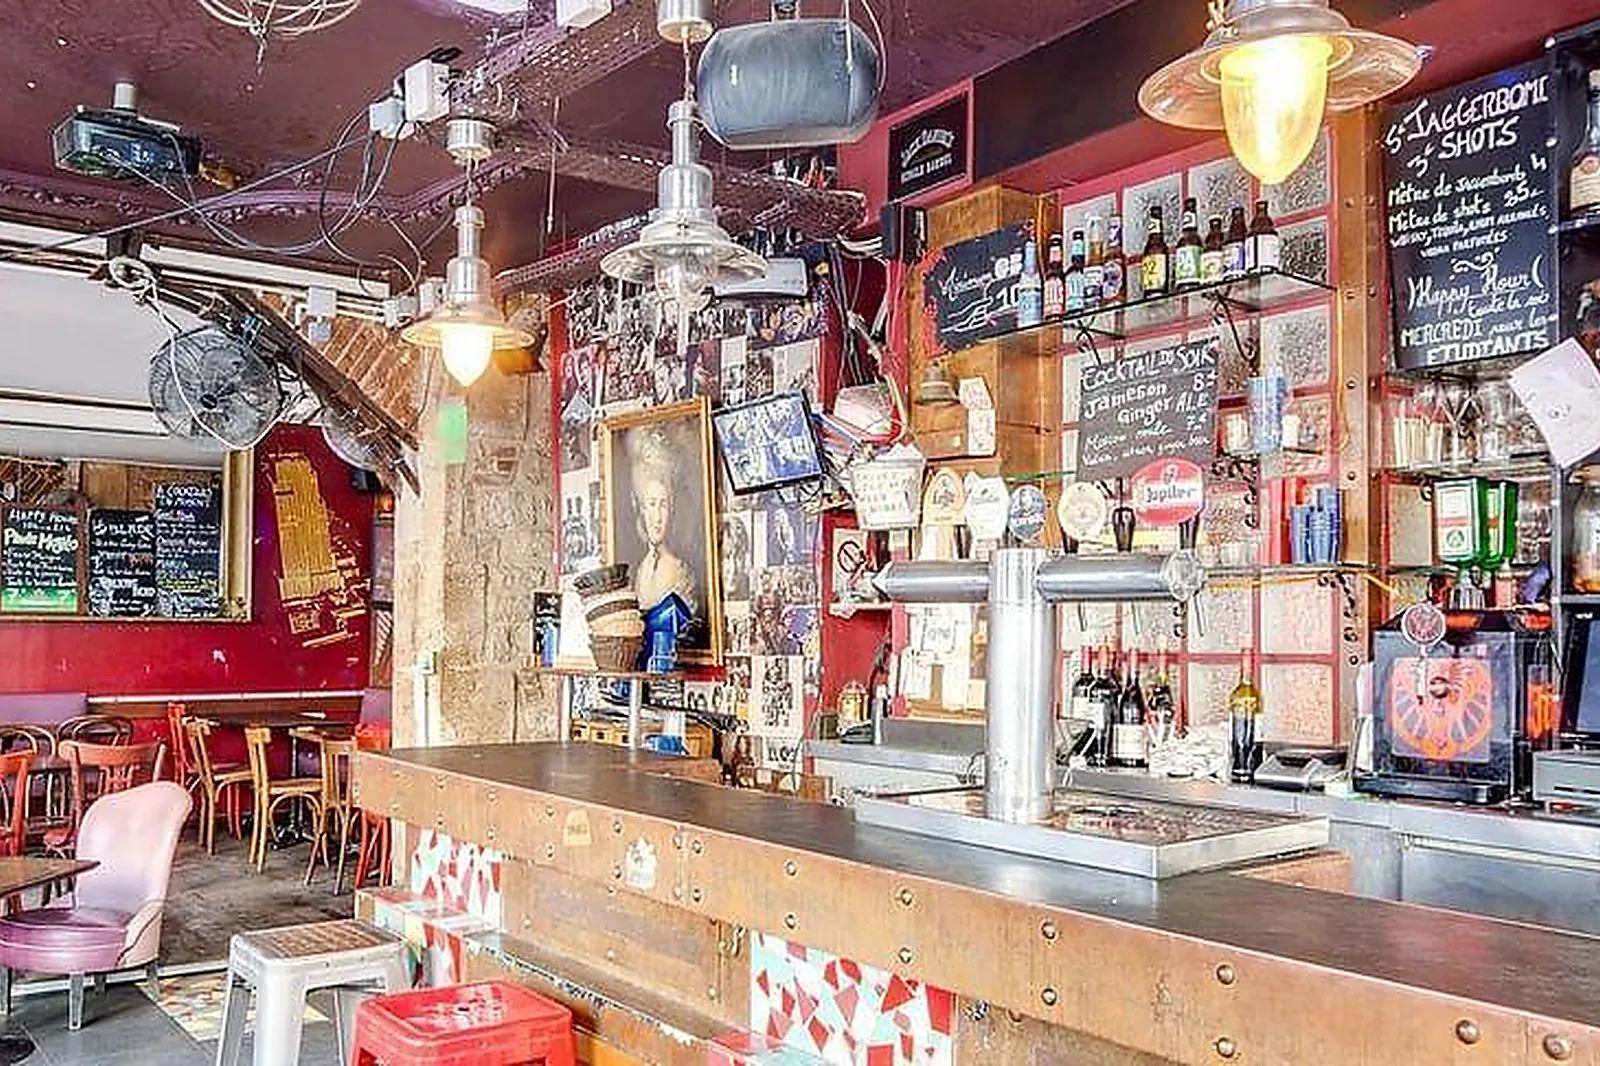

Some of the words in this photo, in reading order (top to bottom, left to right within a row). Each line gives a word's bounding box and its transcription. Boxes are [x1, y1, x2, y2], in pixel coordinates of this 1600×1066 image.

[1438, 115, 1520, 159] SHOTS
[1433, 172, 1452, 197] de
[1432, 202, 1448, 225] de
[1453, 193, 1492, 218] shots
[1400, 317, 1484, 347] MERCREDI
[1083, 355, 1160, 390] COCKTAIL
[1176, 346, 1215, 371] SOIR
[1084, 384, 1167, 419] Jameson
[1117, 396, 1173, 426] Ginger
[1146, 484, 1197, 503] Jupiler
